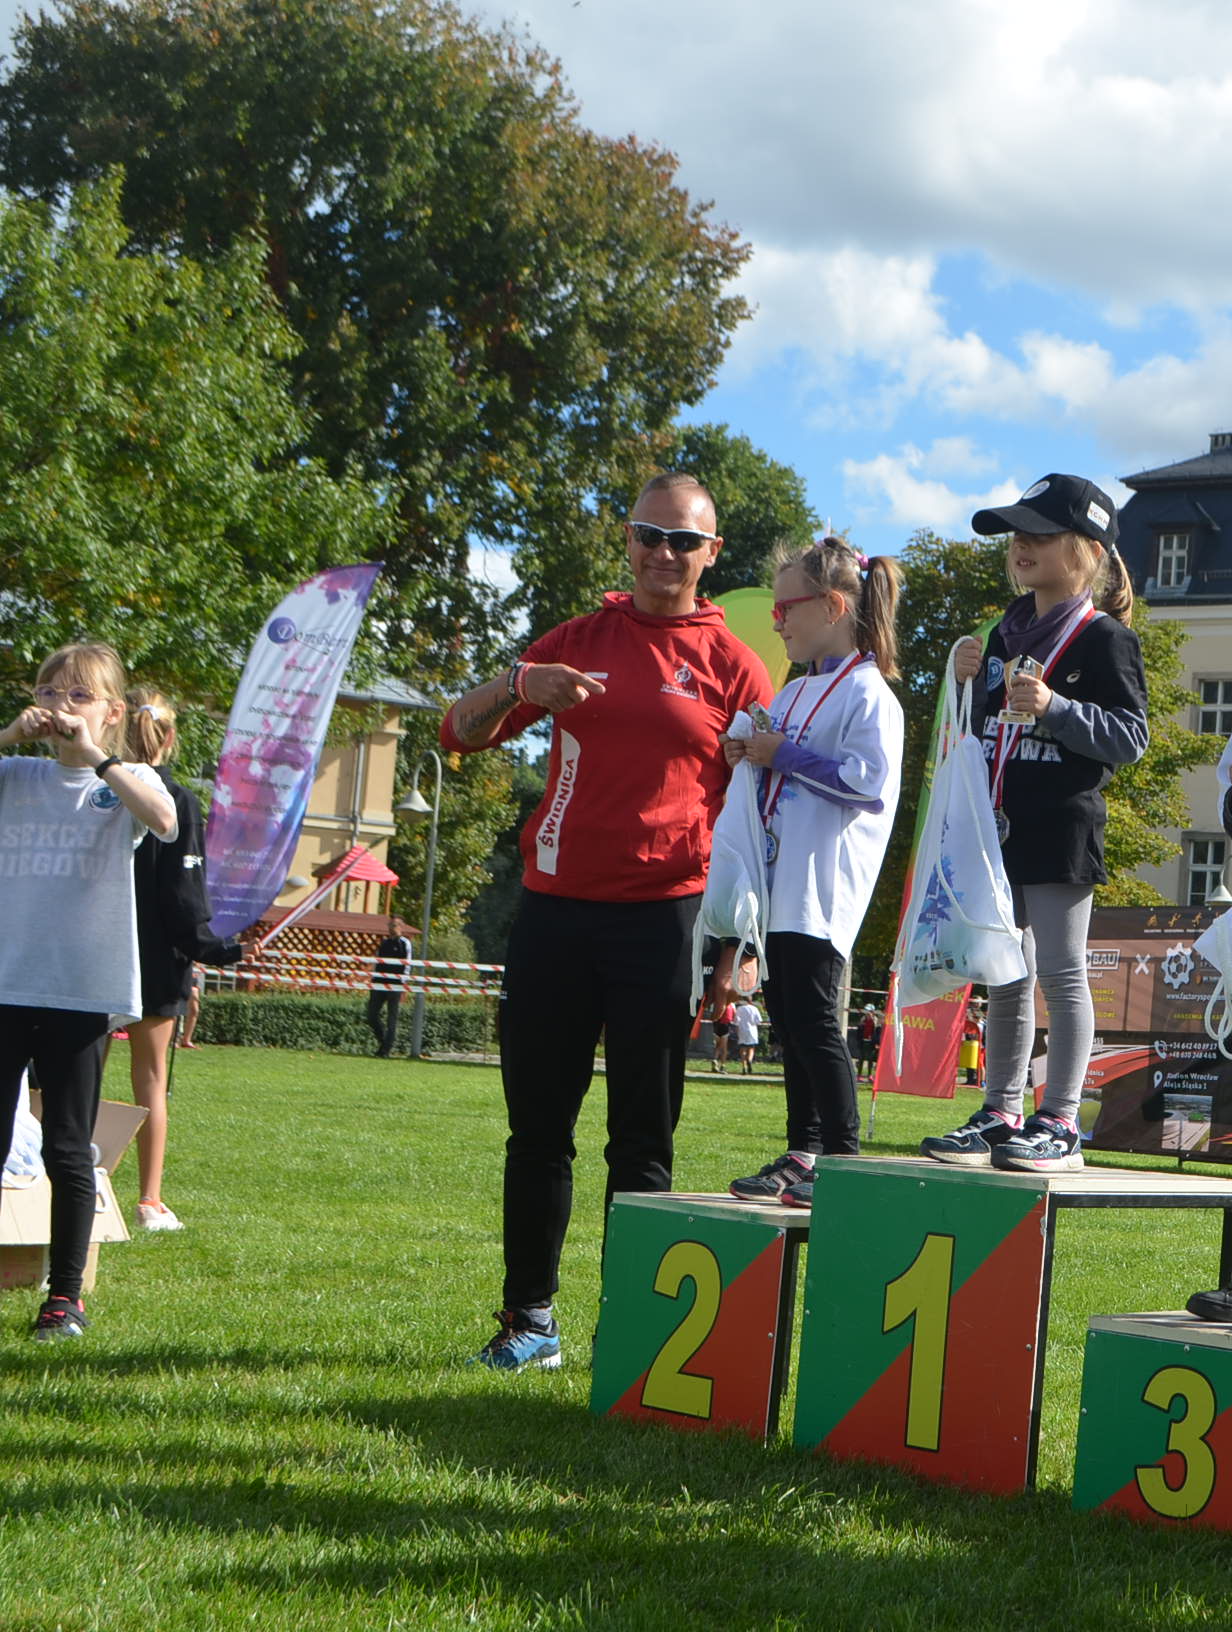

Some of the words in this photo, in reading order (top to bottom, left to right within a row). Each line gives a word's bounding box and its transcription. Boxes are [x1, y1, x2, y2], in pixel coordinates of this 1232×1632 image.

[538, 759, 575, 848] ŚWIDNICA
[1190, 1073, 1219, 1081] Wrocław
[641, 1240, 722, 1419] 2
[882, 1232, 956, 1452] 1
[1135, 1364, 1217, 1520] 3
